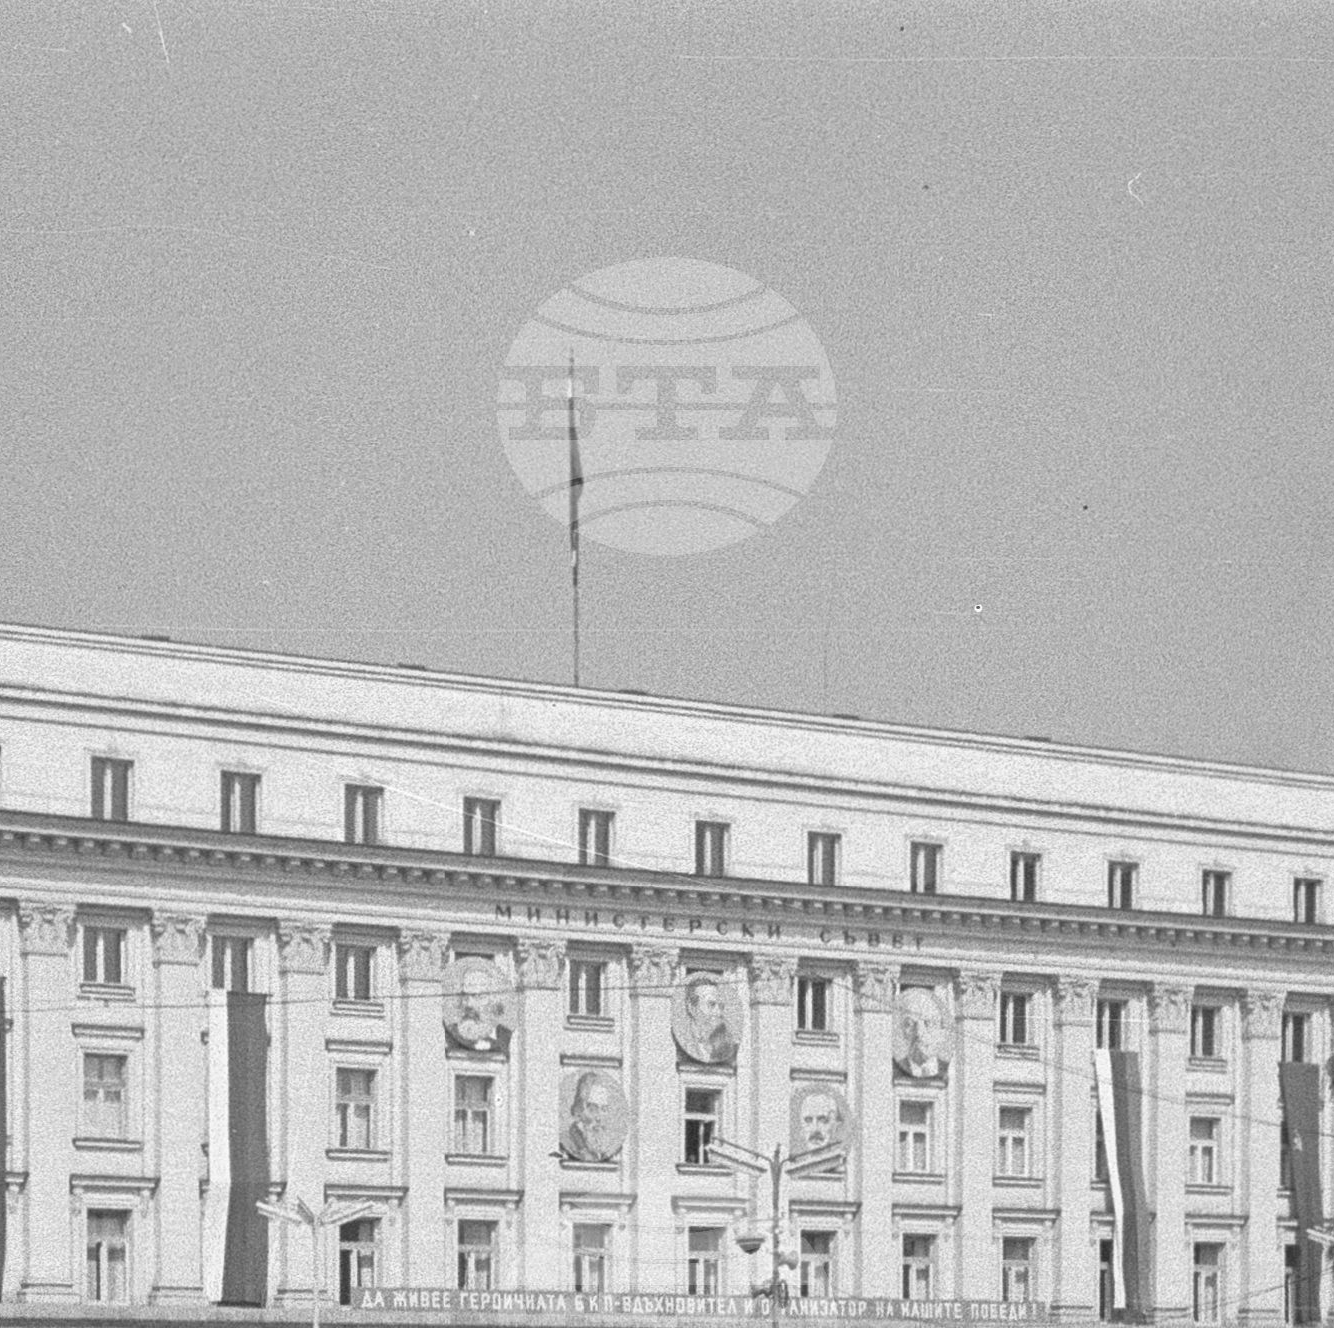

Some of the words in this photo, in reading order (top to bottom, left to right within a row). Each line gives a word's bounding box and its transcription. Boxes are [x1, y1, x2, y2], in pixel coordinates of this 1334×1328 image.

[495, 904, 782, 940] МИНИСТЕРСКИ
[819, 928, 925, 950] СЪВЕТ
[361, 1290, 385, 1308] ДА
[394, 1290, 451, 1309] ЖИВЕЕ
[460, 1292, 567, 1311] ГЕРОИЧНАТА
[761, 1299, 867, 1317] ОАНИЗАТОР
[875, 1301, 894, 1318] НА
